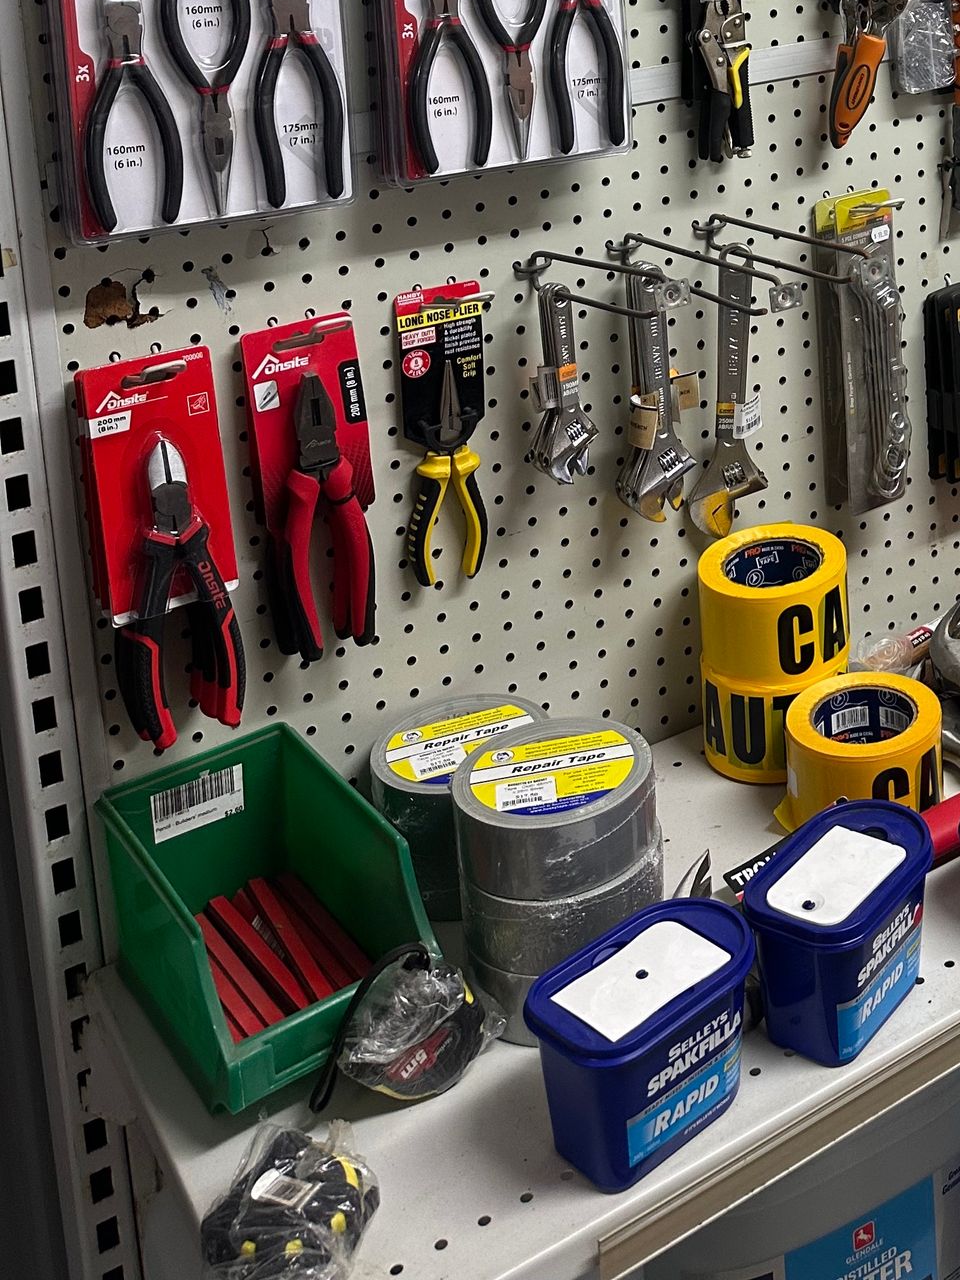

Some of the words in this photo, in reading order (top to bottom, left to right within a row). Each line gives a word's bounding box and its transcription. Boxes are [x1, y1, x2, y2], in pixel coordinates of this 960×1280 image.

[185, 3, 223, 16] 160mm
[191, 18, 202, 30] (6
[572, 77, 601, 87] 175mm
[428, 95, 460, 105] 160mm
[282, 121, 319, 133] 175mm
[288, 134, 298, 147] (7
[106, 143, 146, 156] 160mm
[113, 157, 124, 170] (6
[399, 315, 425, 329] LONG
[426, 309, 451, 323] NOSE
[453, 303, 480, 317] PLIER
[402, 332, 419, 341] HEAVY
[420, 329, 435, 337] DUTY
[264, 355, 311, 375] Onsite
[456, 353, 482, 365] Comfort
[462, 362, 476, 371] Soft
[462, 369, 477, 378] Grip
[106, 393, 148, 410] Onsite
[348, 391, 359, 403] mm
[350, 404, 361, 418] 200
[97, 417, 113, 428] 200
[113, 415, 127, 424] mm
[744, 545, 761, 558] PRO
[423, 733, 472, 751] Repair
[473, 722, 509, 739] Tape
[511, 758, 564, 774] Repair
[568, 751, 606, 765] Tape
[872, 903, 911, 955] SELLEYS
[860, 960, 904, 1024] RAPID
[668, 1010, 730, 1063] SELLEYS
[646, 1010, 742, 1098] SPAKFILLA
[653, 1073, 720, 1138] RAPID
[845, 1237, 884, 1266] GLENDALE
